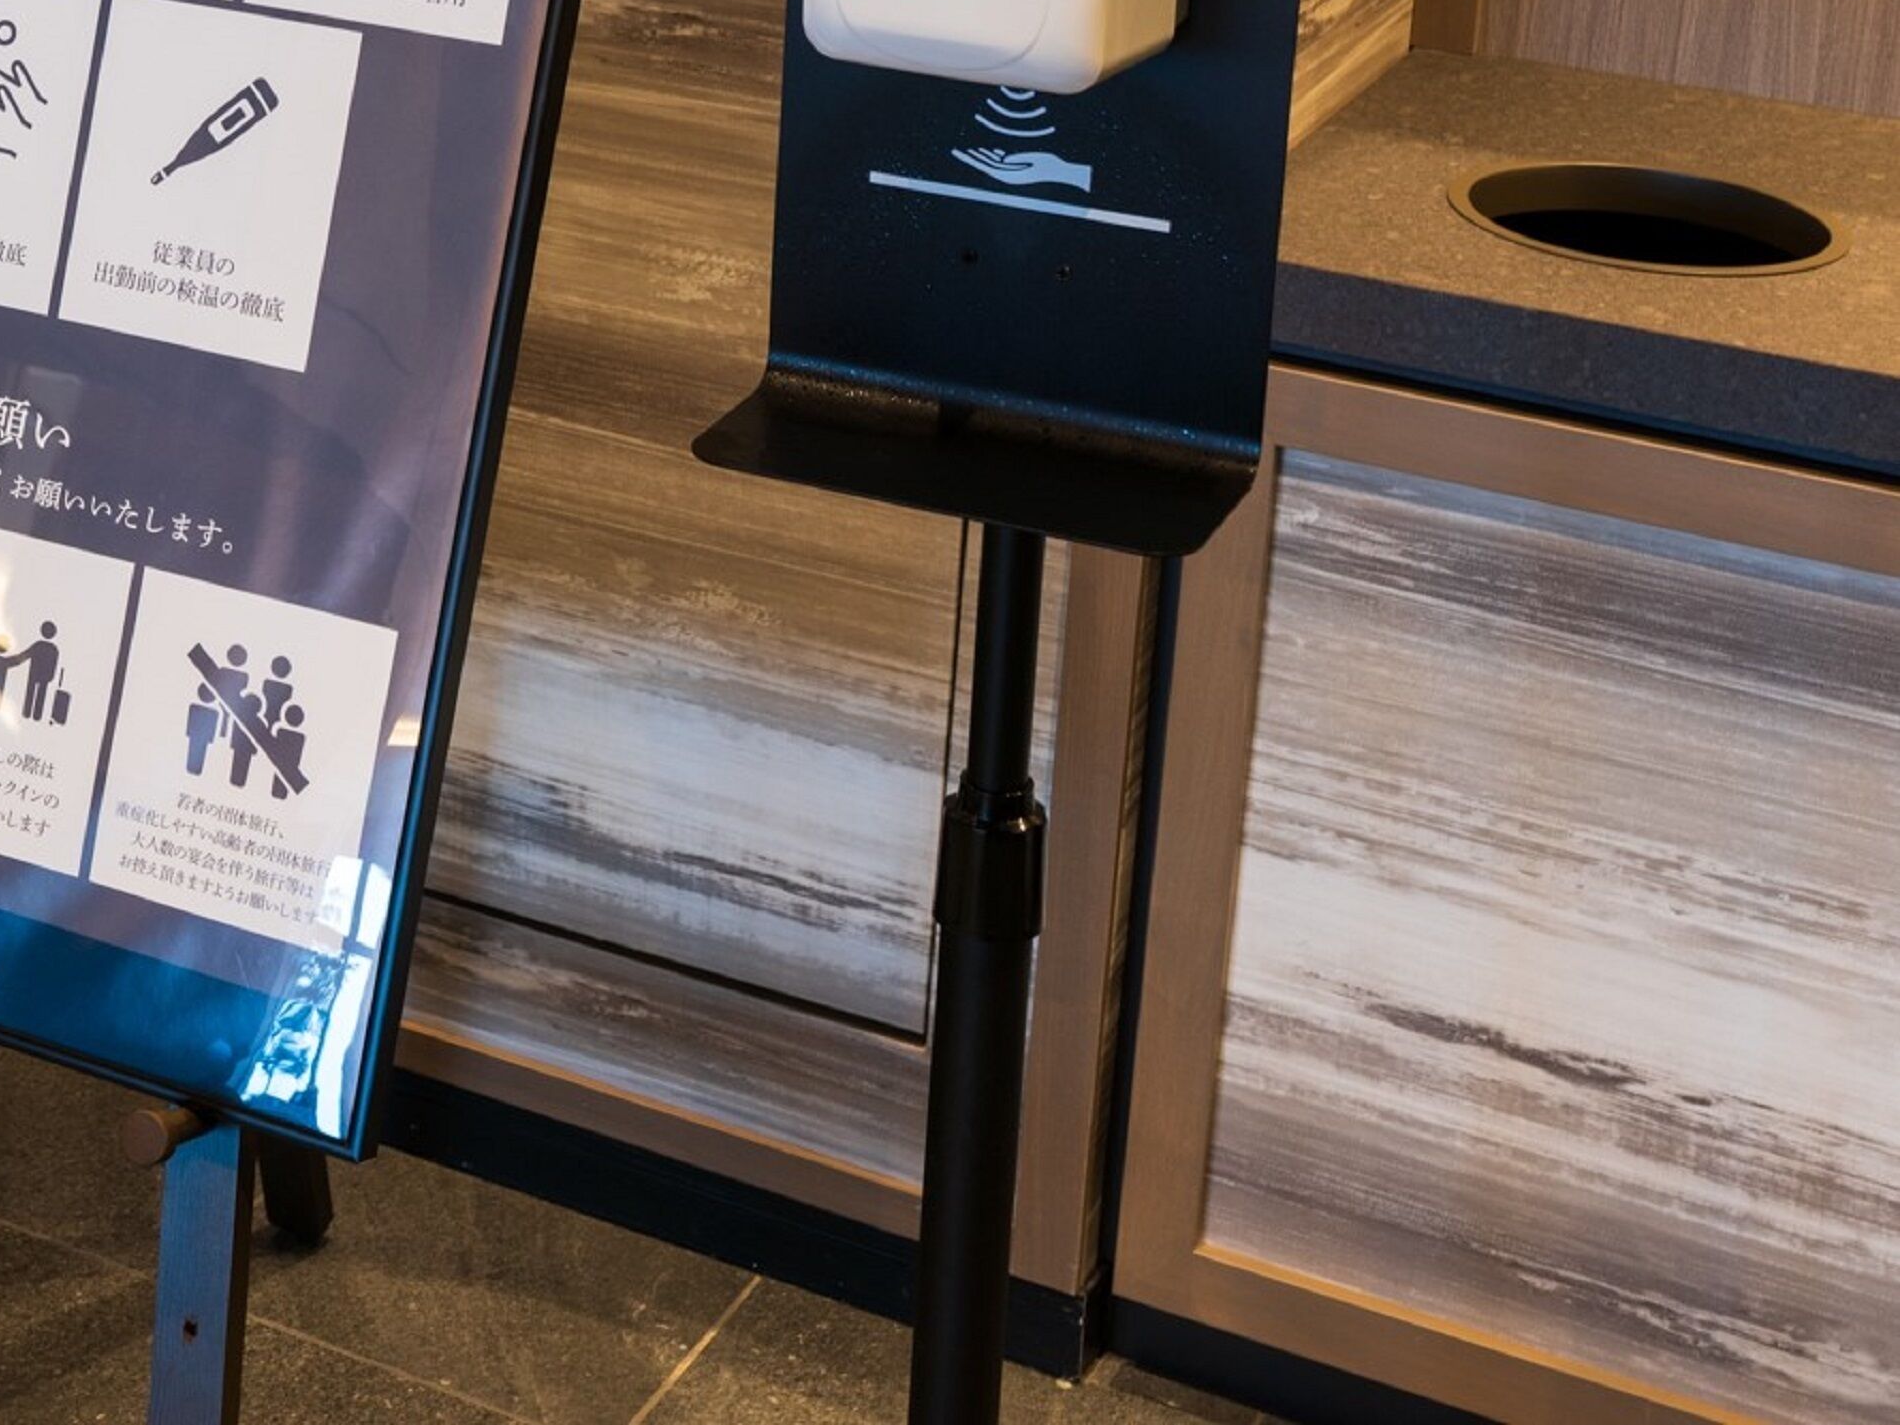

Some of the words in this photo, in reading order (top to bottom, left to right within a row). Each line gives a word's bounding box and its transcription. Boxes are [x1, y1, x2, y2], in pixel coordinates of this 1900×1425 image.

[152, 239, 236, 277] 従業員の
[92, 260, 286, 323] 出勤前の検温の徹底
